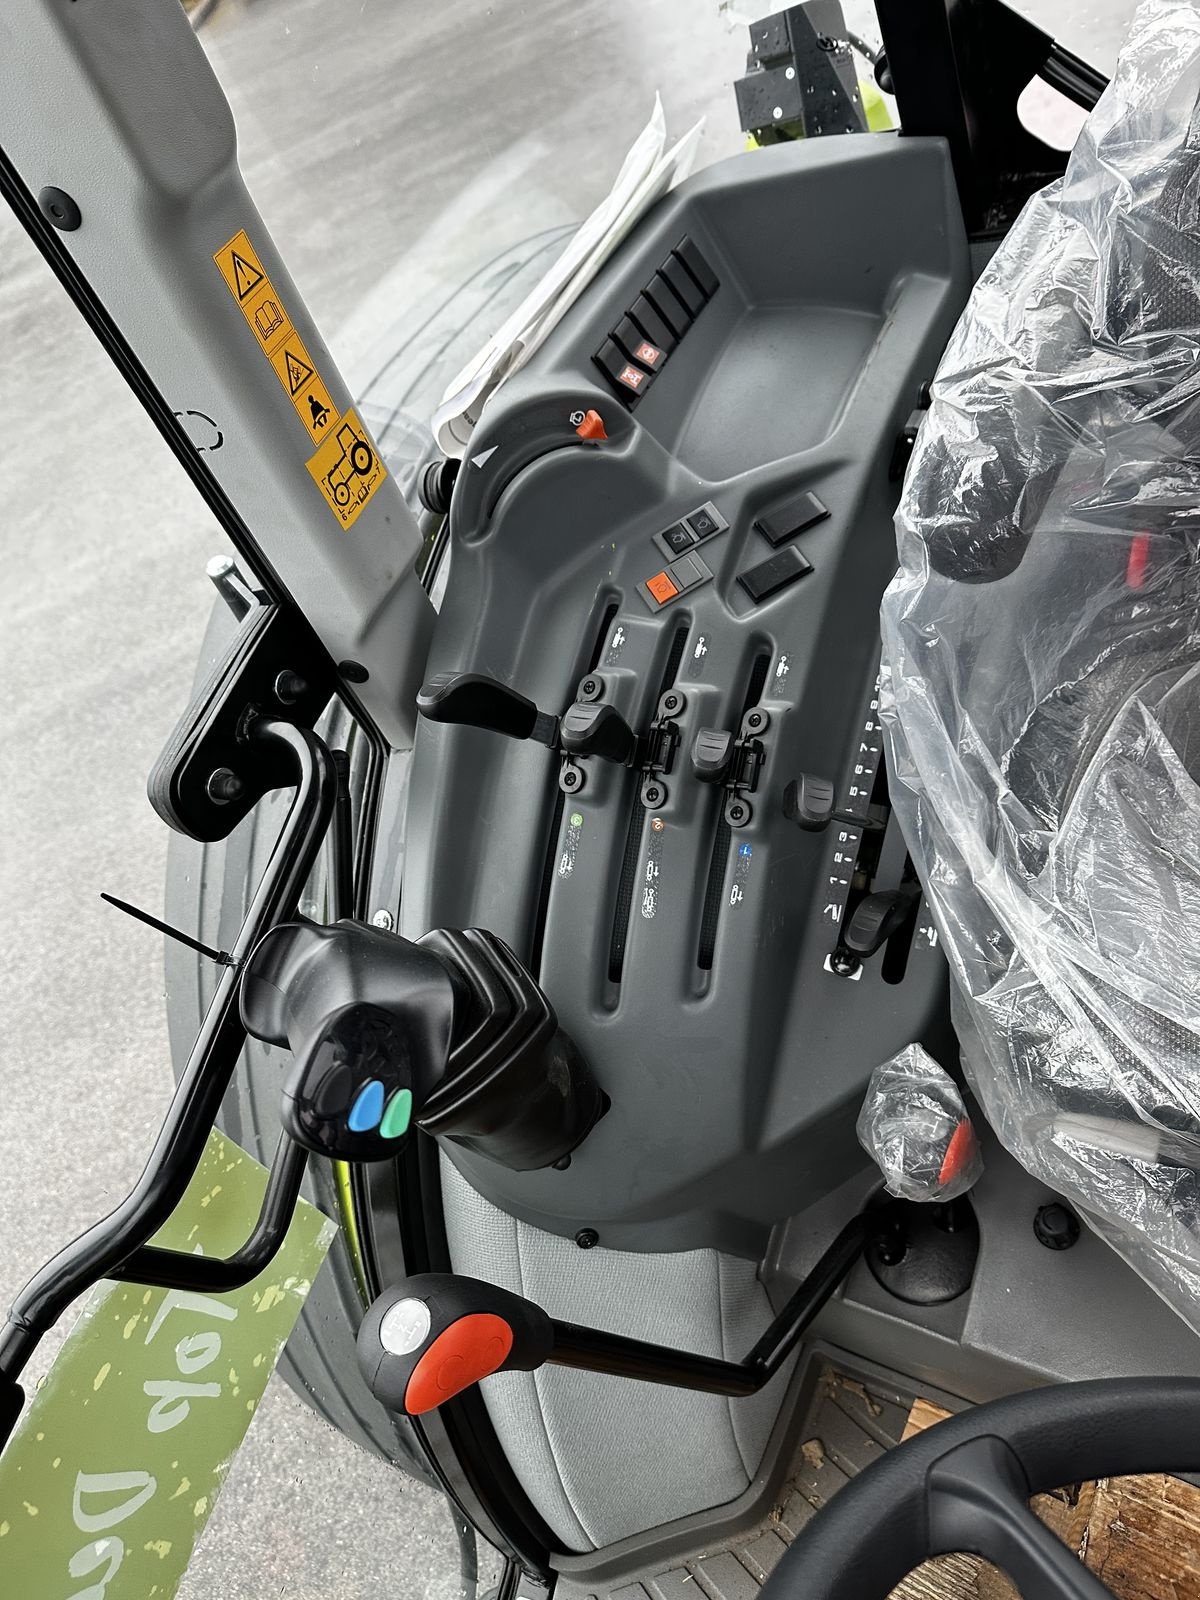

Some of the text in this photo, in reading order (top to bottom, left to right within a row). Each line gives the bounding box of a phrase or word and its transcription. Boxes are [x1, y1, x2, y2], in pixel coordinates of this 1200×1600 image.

[833, 852, 843, 863] 2
[838, 831, 848, 842] 3
[849, 786, 858, 797] 5
[854, 764, 864, 775] 6
[859, 742, 868, 753] 7
[864, 721, 874, 732] 8
